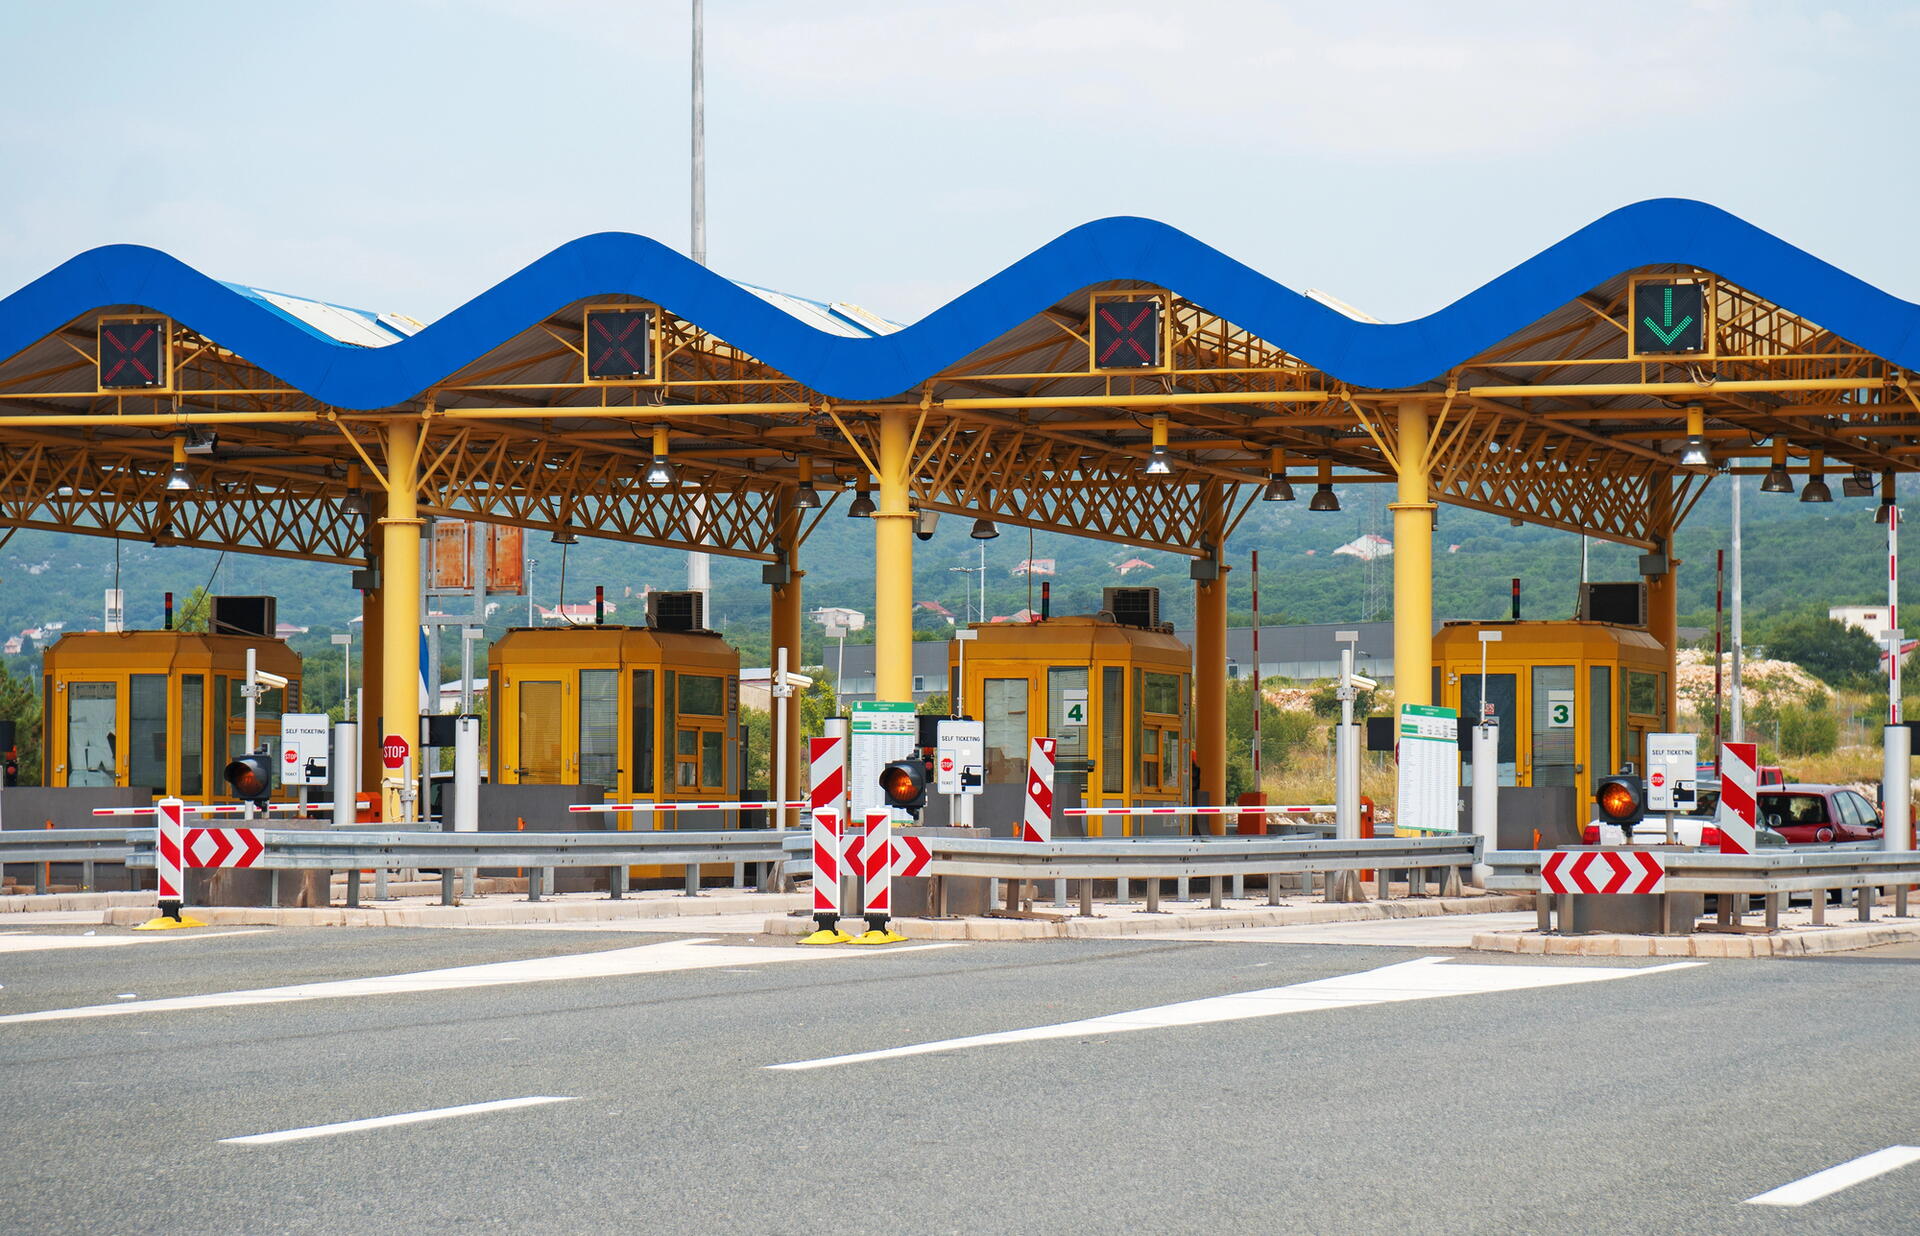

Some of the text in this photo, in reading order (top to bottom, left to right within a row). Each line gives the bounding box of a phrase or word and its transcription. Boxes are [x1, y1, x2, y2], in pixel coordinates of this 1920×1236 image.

[1067, 703, 1083, 722] 4
[1553, 704, 1569, 724] 3
[383, 745, 406, 758] STOP
